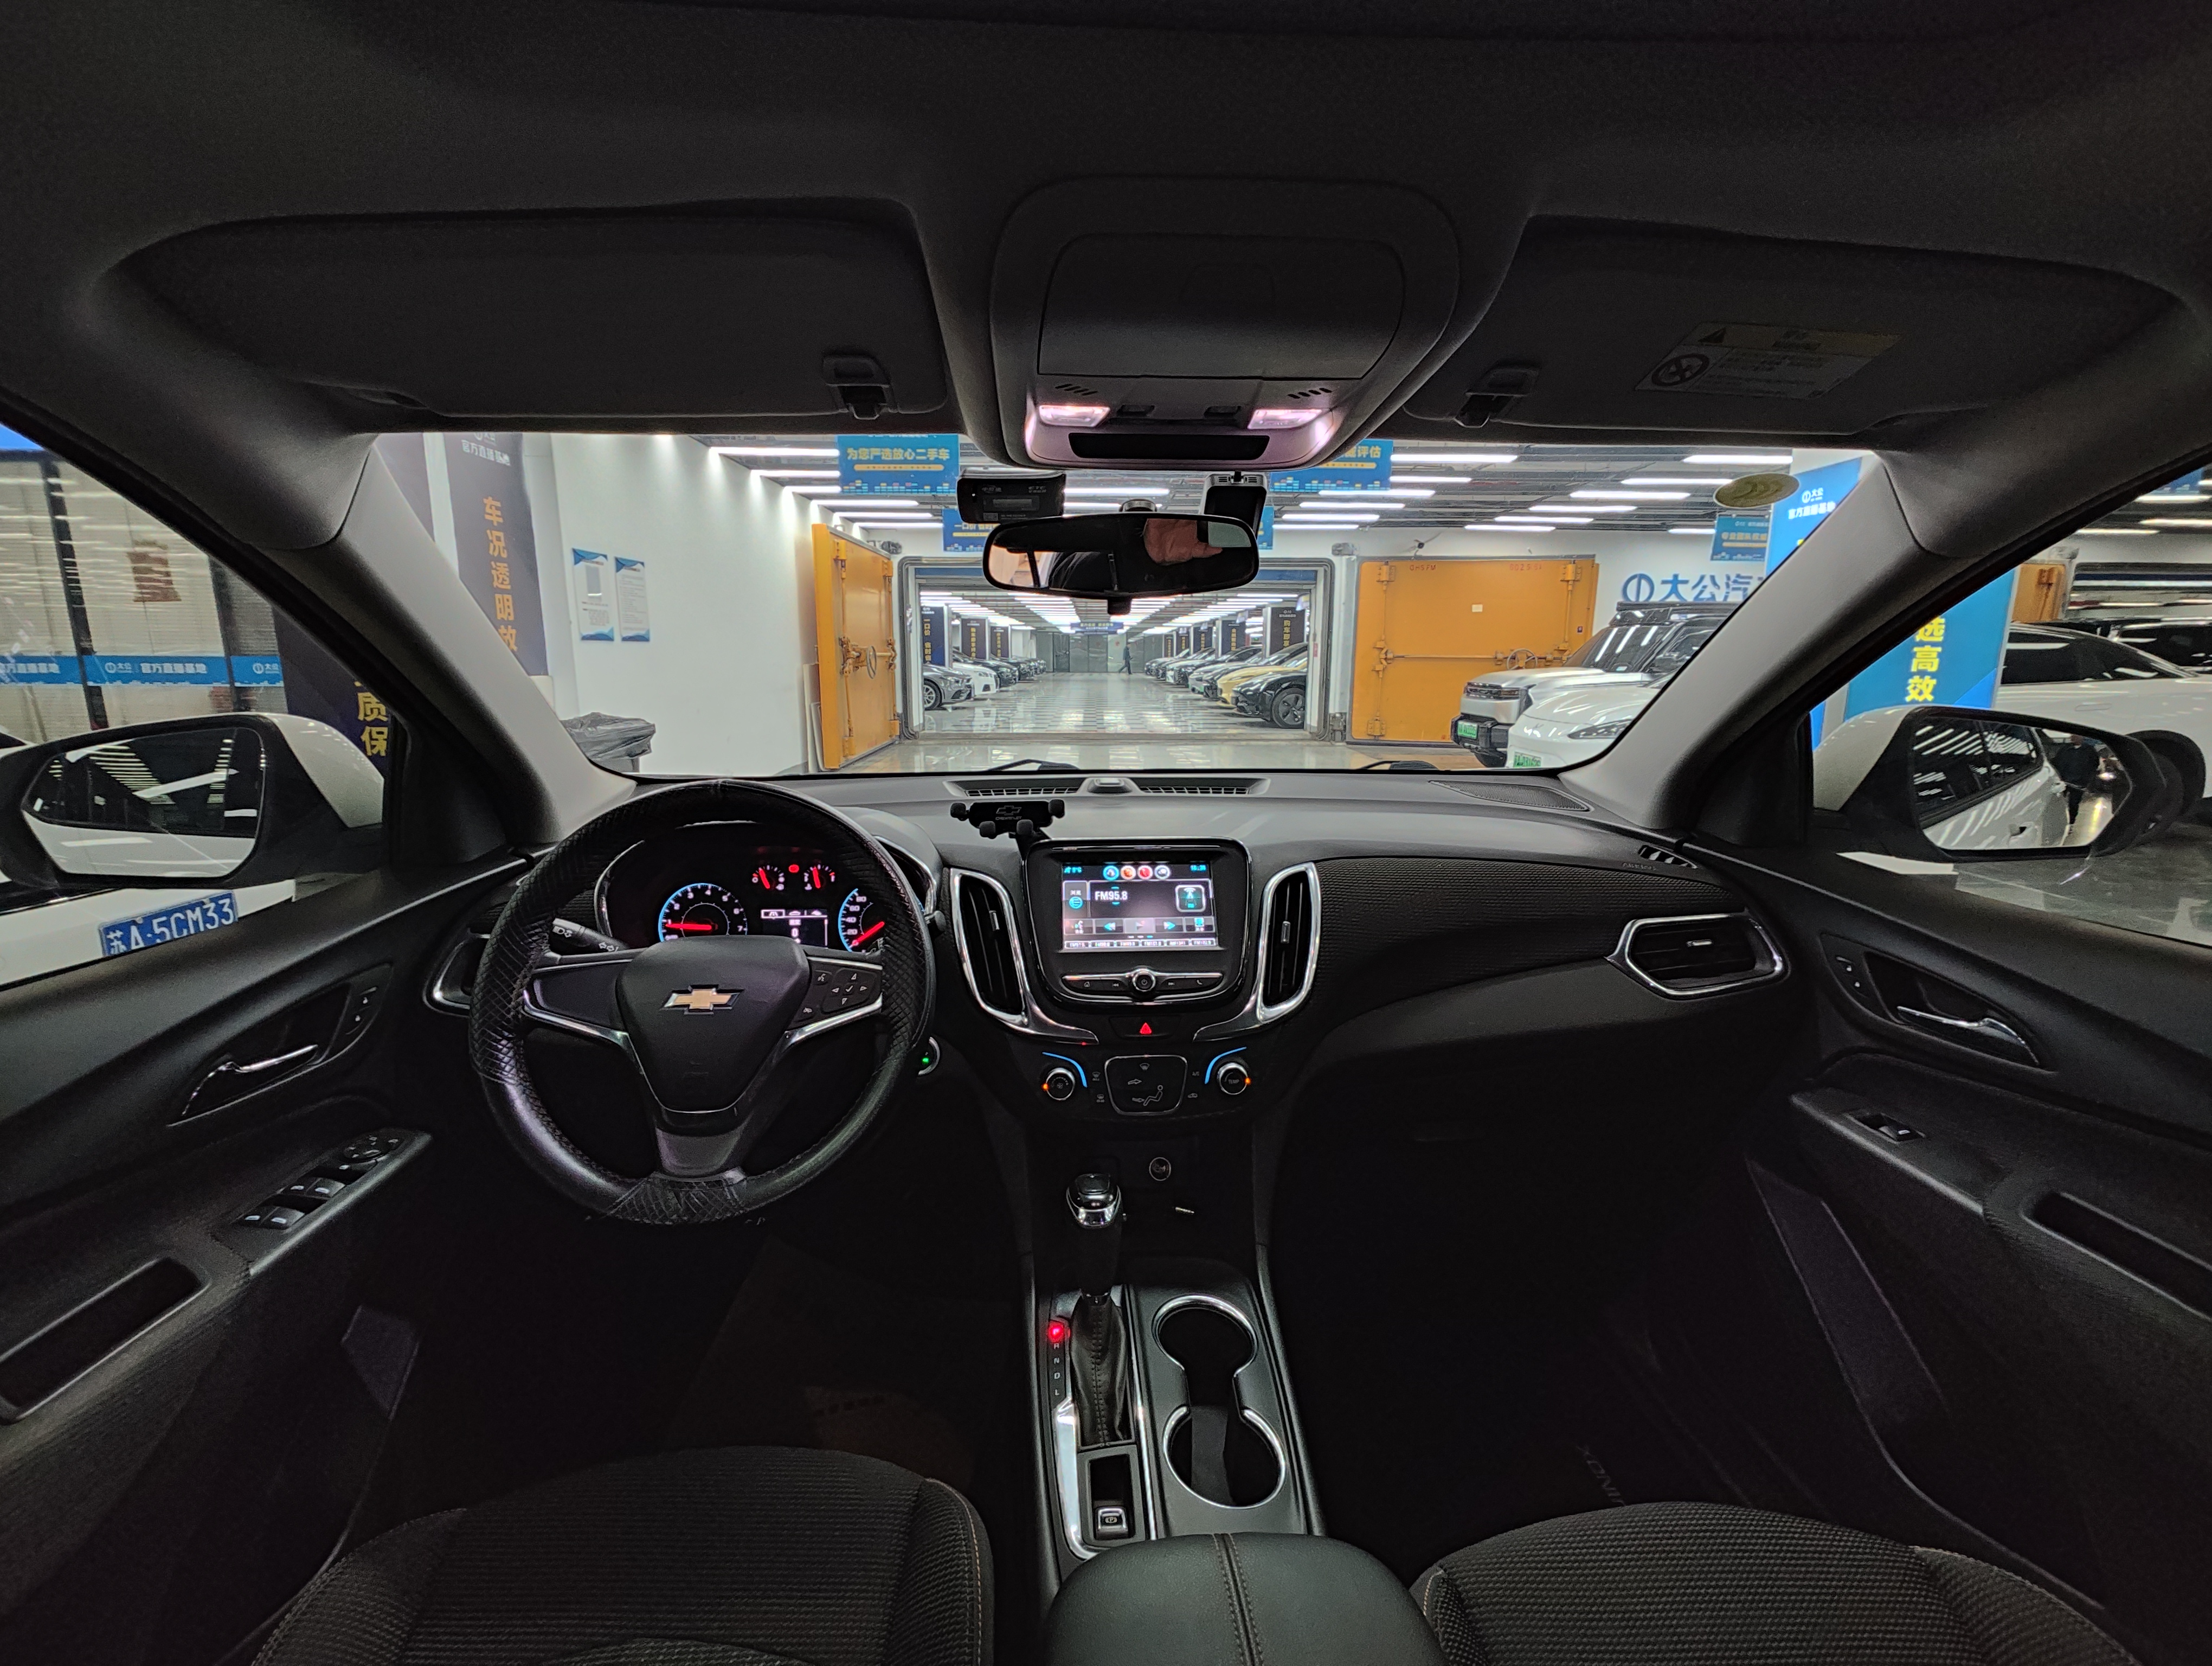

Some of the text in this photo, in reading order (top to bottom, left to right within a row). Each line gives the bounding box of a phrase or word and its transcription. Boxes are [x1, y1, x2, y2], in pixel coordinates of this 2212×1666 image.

[847, 447, 950, 460] 为您严选放心二手车
[483, 496, 517, 651] 车况透明放
[1660, 573, 1765, 602] 大公汽
[1905, 616, 1945, 702] 选高效
[355, 681, 388, 757] 质保
[1095, 891, 1128, 900] FM95.8
